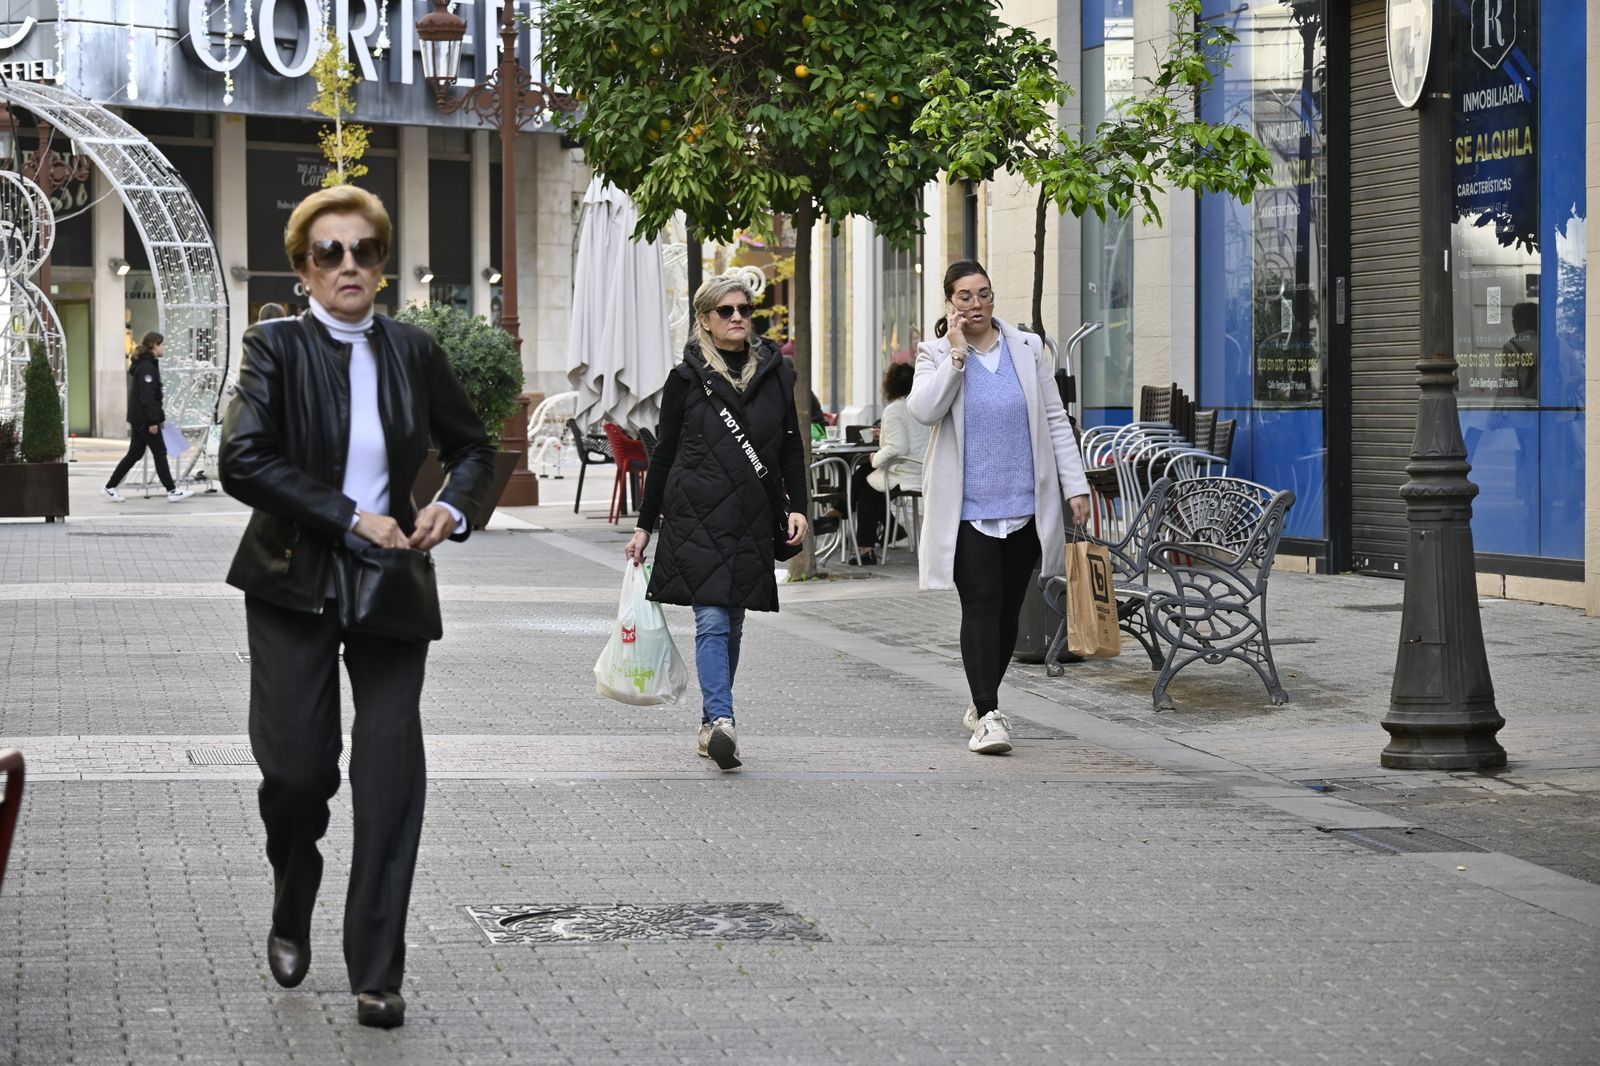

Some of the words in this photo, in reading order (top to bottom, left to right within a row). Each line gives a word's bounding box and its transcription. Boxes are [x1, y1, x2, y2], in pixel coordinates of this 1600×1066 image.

[1463, 83, 1524, 113] INMOBILIARIA
[1262, 119, 1311, 144] INMOBILIARIA
[1455, 135, 1473, 166] SE
[1475, 126, 1533, 163] ALQUILA
[1508, 352, 1519, 367] 234
[720, 407, 740, 434] LOLA
[735, 433, 745, 443] Y
[741, 440, 763, 471] BIMBA
